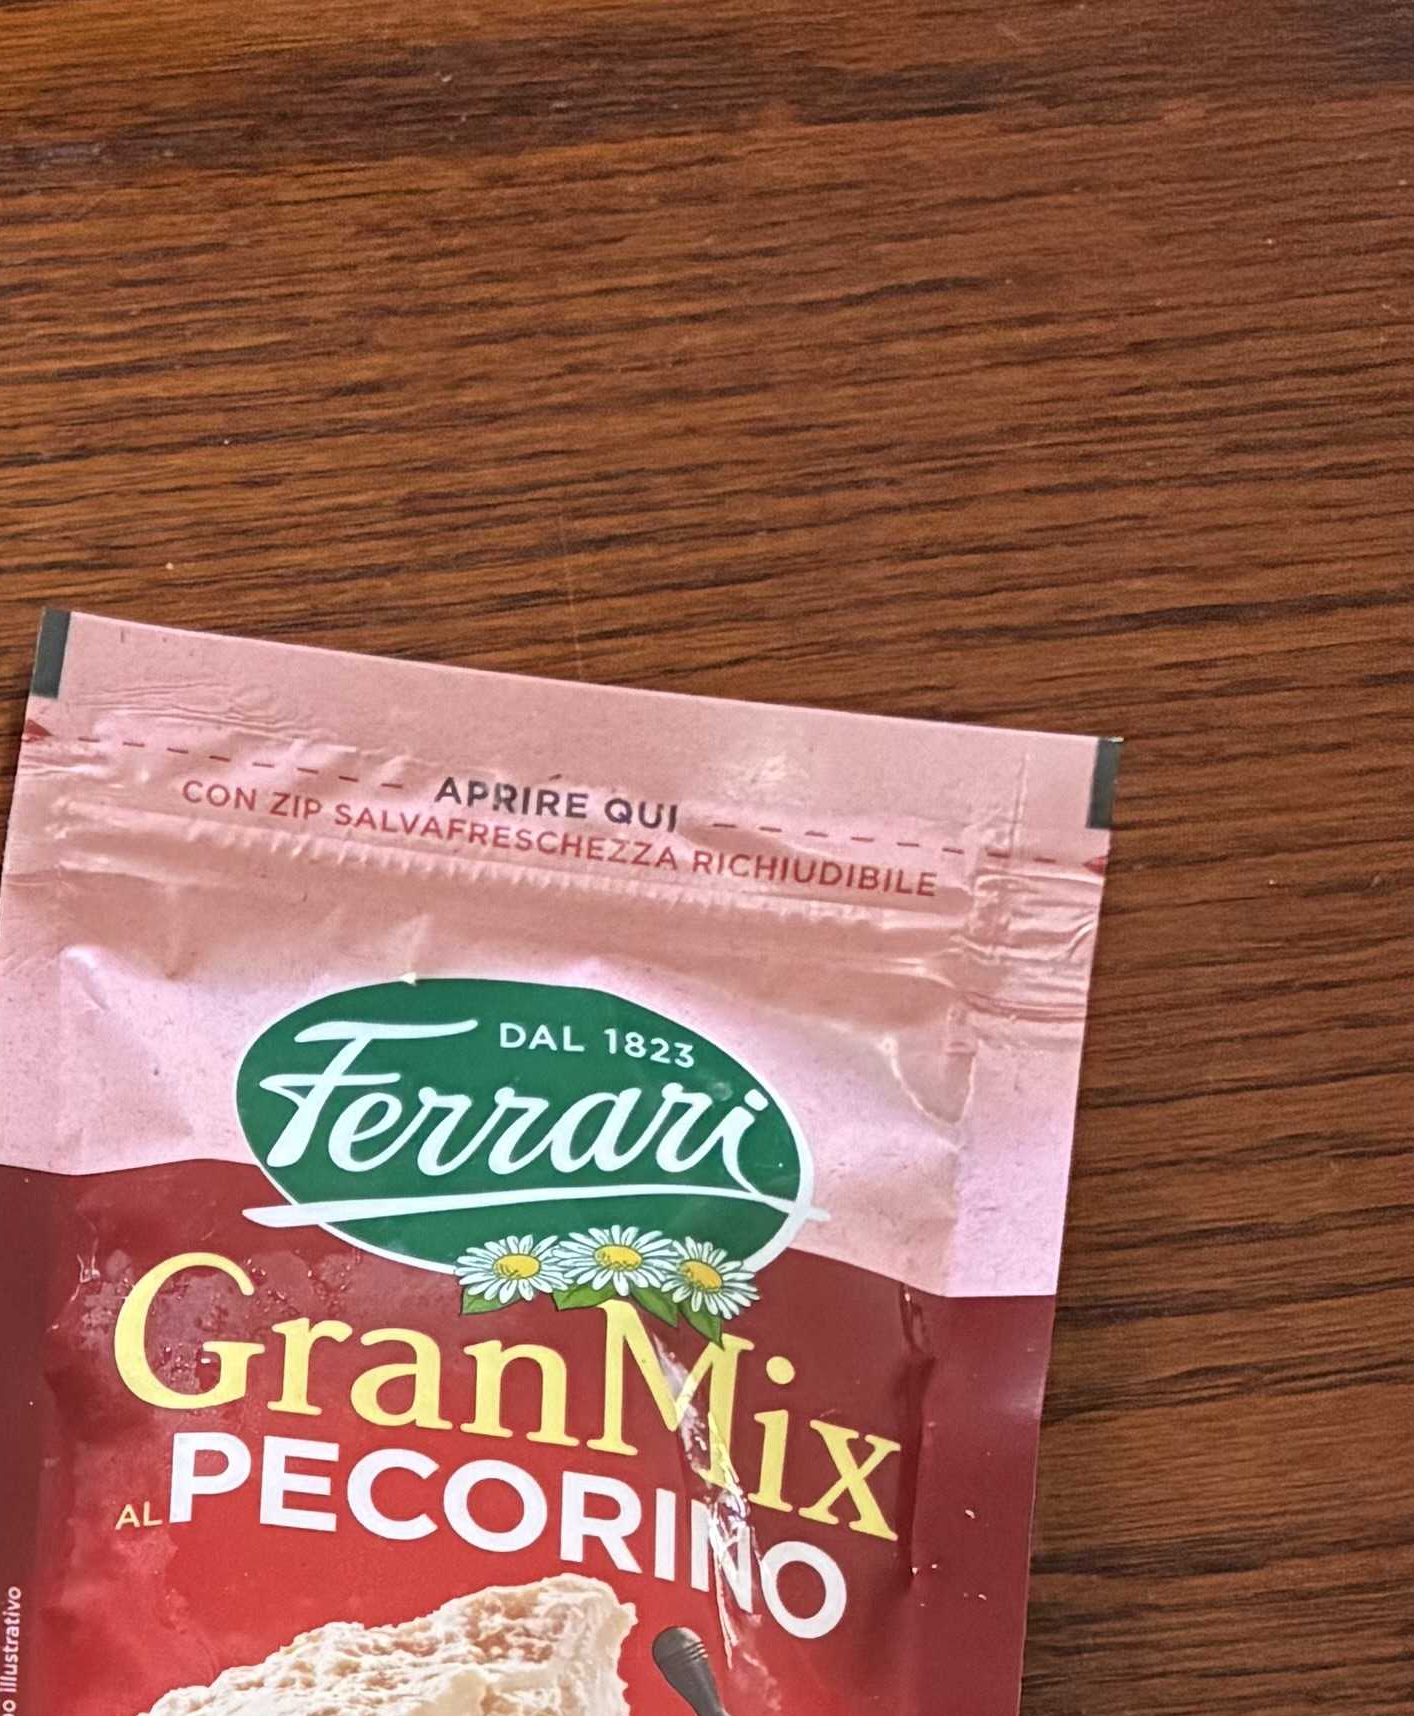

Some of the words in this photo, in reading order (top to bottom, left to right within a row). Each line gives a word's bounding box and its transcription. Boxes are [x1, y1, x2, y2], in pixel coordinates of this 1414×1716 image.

[182, 780, 257, 811] CON
[269, 792, 322, 820] ZIP
[334, 804, 678, 871] SALVAFRESCHEZZA
[692, 850, 937, 897] RICHIUDIBILE
[435, 776, 588, 819] APRIRE
[604, 797, 679, 832] QUI
[259, 1018, 772, 1200] Ferrari
[499, 1022, 584, 1053] DAL
[604, 1028, 696, 1068] 1823
[112, 1251, 901, 1541] GranMix
[115, 1501, 164, 1531] AL
[169, 1430, 847, 1639] PECORINO
